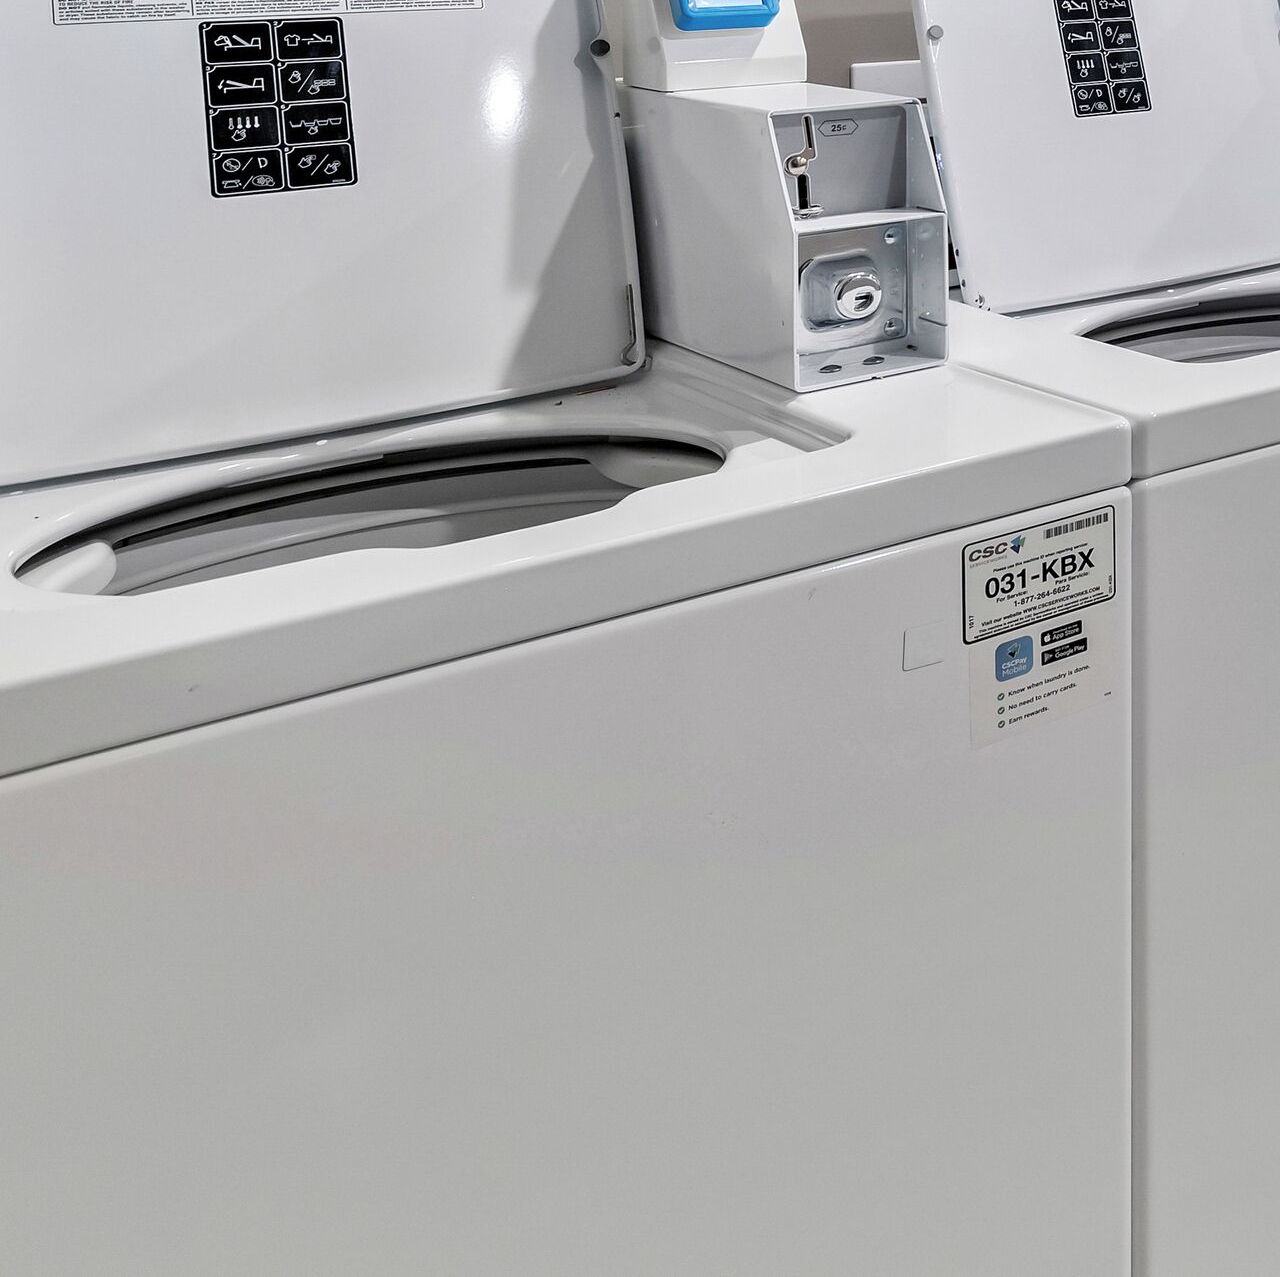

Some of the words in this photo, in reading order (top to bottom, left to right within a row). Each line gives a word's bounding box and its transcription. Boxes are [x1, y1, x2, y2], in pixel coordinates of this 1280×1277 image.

[258, 157, 268, 169] D
[968, 542, 1008, 563] CSC
[984, 548, 1095, 599] 031-KBX
[1055, 577, 1067, 585] Para
[1068, 571, 1090, 582] Servicio:
[1006, 590, 1028, 601] Service:
[1014, 584, 1071, 607] 1-877-264-6622
[981, 619, 992, 627] Visit
[1002, 611, 1022, 620] website
[1022, 586, 1100, 614] WWW.CSCSERVICEWORKS.COM
[1052, 631, 1064, 641] App
[1064, 627, 1080, 637] Store
[1054, 648, 1074, 659] Google
[1074, 644, 1085, 654] Play
[1002, 657, 1027, 670] CSCPay
[1002, 663, 1027, 677] Mobile
[1008, 687, 1026, 697] Know
[1026, 681, 1044, 691] when
[1044, 673, 1066, 685] laundry
[1074, 665, 1090, 674] done.
[1008, 703, 1018, 711] No
[1018, 697, 1035, 707] need
[1035, 693, 1042, 701] to
[1042, 688, 1059, 699] carry
[1059, 682, 1077, 693] cards.
[1008, 716, 1023, 724] Earn
[1024, 706, 1050, 718] rewards.
